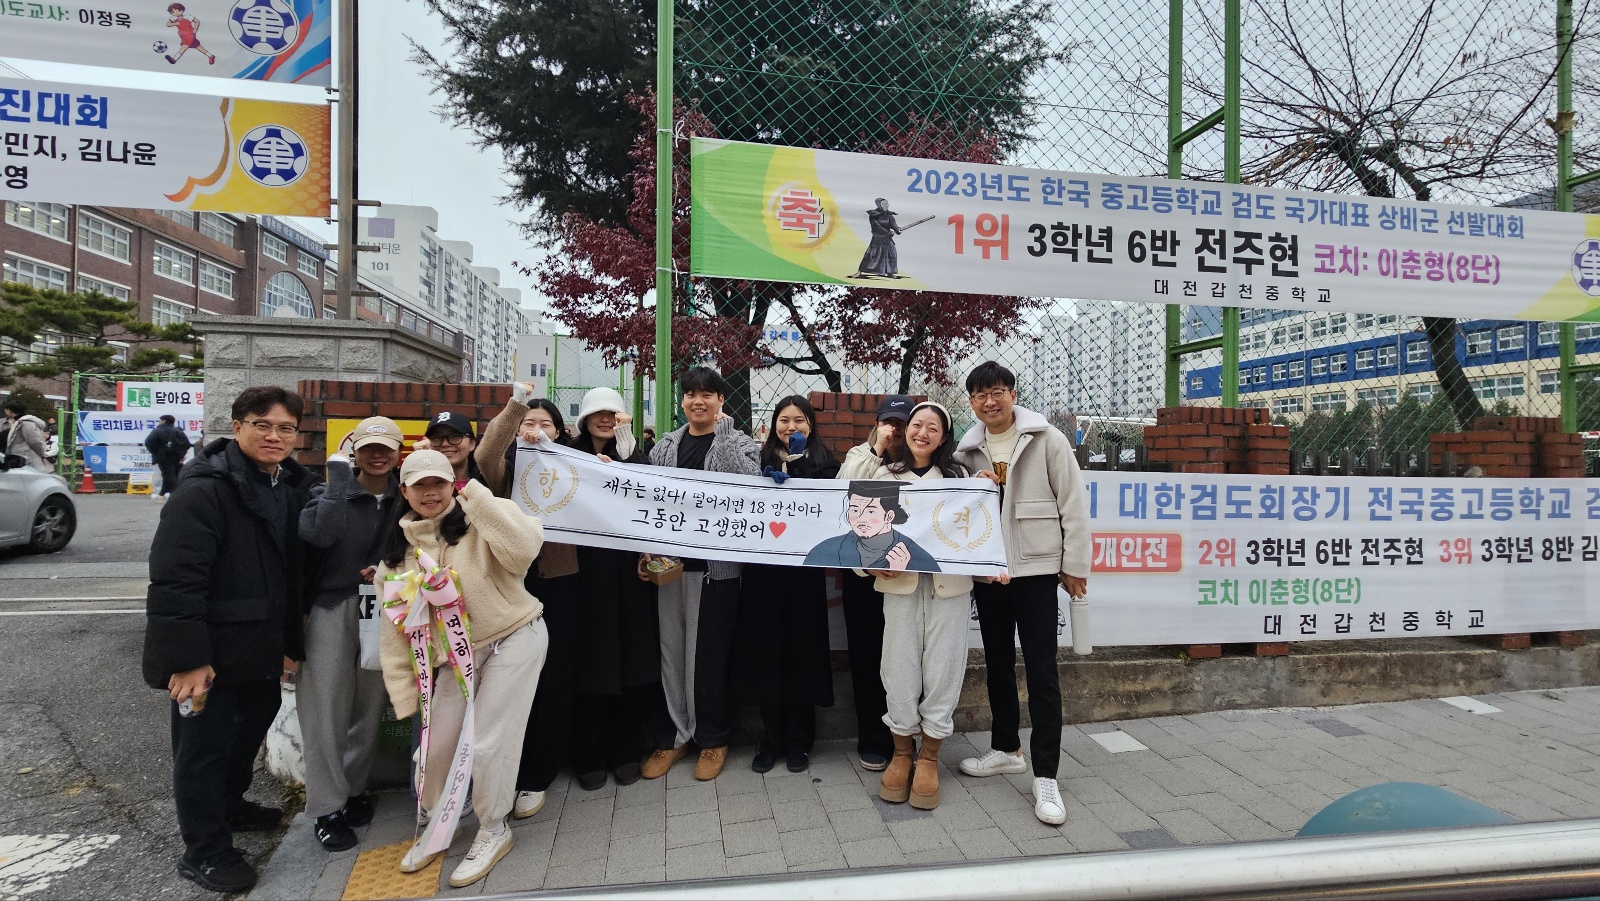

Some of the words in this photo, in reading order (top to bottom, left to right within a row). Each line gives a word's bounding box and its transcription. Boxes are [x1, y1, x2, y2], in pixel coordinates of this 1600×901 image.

[78, 9, 131, 28] 이정욱
[0, 88, 108, 129] 진대회
[0, 132, 67, 161] 민지,
[78, 138, 156, 166] 김나윤
[0, 165, 29, 190] 영
[777, 190, 822, 237] 축
[906, 168, 1031, 203] 2023년도
[1040, 177, 1092, 207] 한국
[1100, 182, 1223, 215] 중고등학교
[1231, 191, 1276, 219] 검도
[1284, 197, 1370, 227] 국가대표
[1377, 205, 1440, 234] 상비군
[1446, 210, 1525, 239] 선발대회
[947, 212, 1011, 262] 1위
[1026, 221, 1114, 264] 3학년
[1127, 229, 1181, 268] 6반
[1194, 227, 1300, 277] 전주현
[1313, 243, 1369, 276] 코치:
[1377, 246, 1501, 285] 이춘형(8단)
[371, 261, 389, 271] 101
[155, 391, 192, 405] 닫아요
[92, 419, 144, 431] 물리치료사
[539, 468, 560, 498] 합
[602, 477, 648, 499] 재수는
[653, 485, 686, 505] 없다!
[692, 491, 745, 515] 떨어지면
[750, 501, 766, 515] 18
[771, 501, 823, 519] 망신이다
[1119, 481, 1350, 522] 대한검도회장기
[1368, 485, 1572, 522] 전국중고등학교
[631, 507, 687, 532] 그동안
[693, 516, 766, 540] 고생했어
[952, 505, 971, 539] 격
[1094, 536, 1169, 569] 개인전
[1198, 537, 1237, 567] 2위
[1245, 537, 1306, 567] 3학년
[1315, 538, 1352, 566] 6반
[1360, 536, 1424, 566] 전주현
[1438, 537, 1473, 565] 3위
[1481, 536, 1534, 564] 3학년
[1541, 536, 1575, 563] 8반
[1581, 535, 1599, 562] 김
[1197, 579, 1240, 606] 코치
[1248, 576, 1362, 606] 이춘형(8단)
